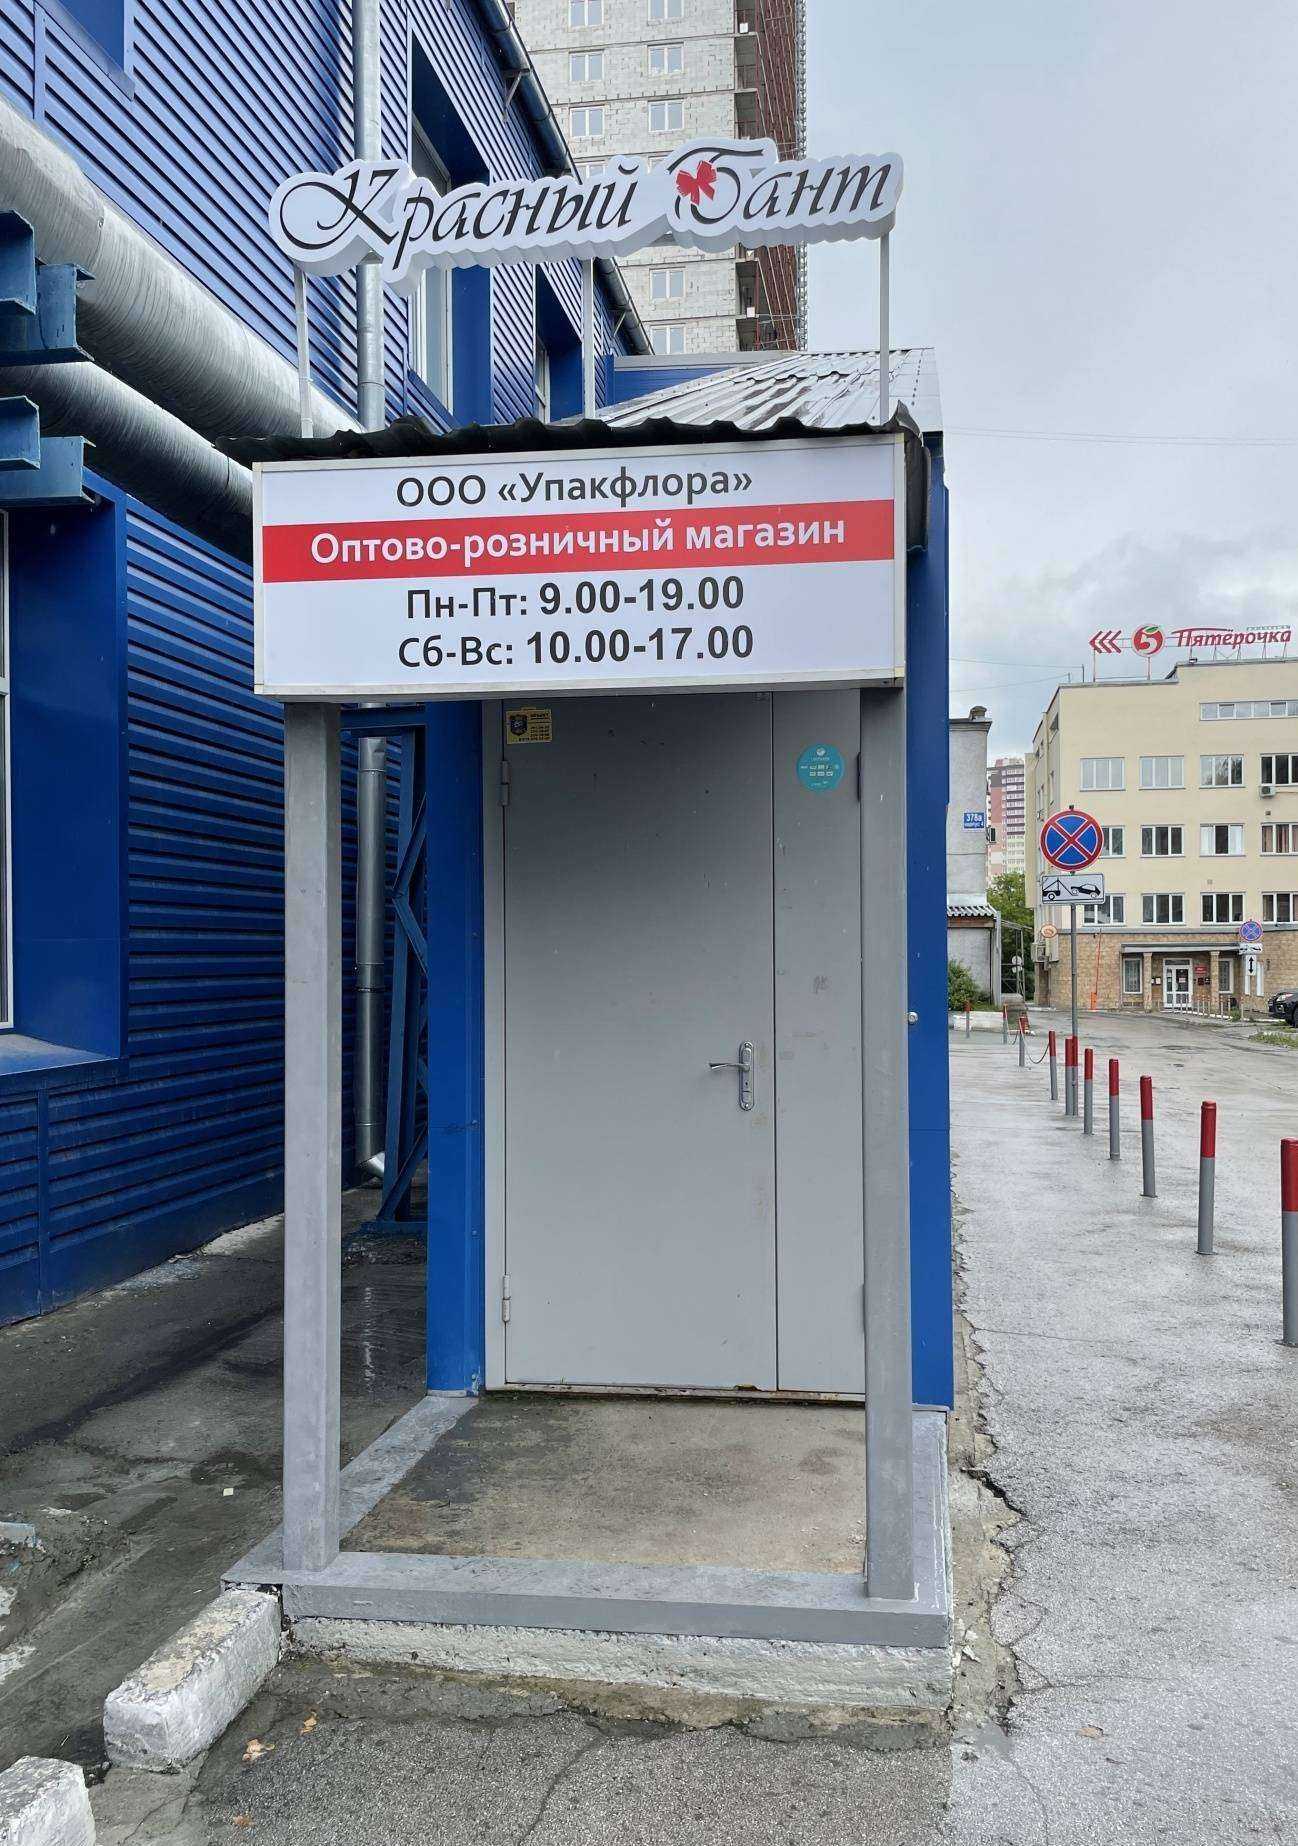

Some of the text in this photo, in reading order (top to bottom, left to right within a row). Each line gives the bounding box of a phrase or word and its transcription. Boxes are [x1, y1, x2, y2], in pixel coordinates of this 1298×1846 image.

[279, 147, 893, 270] Красный Бант
[397, 467, 752, 507] ООО «Упакфлора»
[311, 518, 845, 568] Оптово-розничный магазин
[407, 576, 744, 619] Пн-Пт: 9.00-19.00
[399, 625, 754, 667] Сб-Вс: 10.00-17.00
[1171, 627, 1292, 649] Пятёрочка
